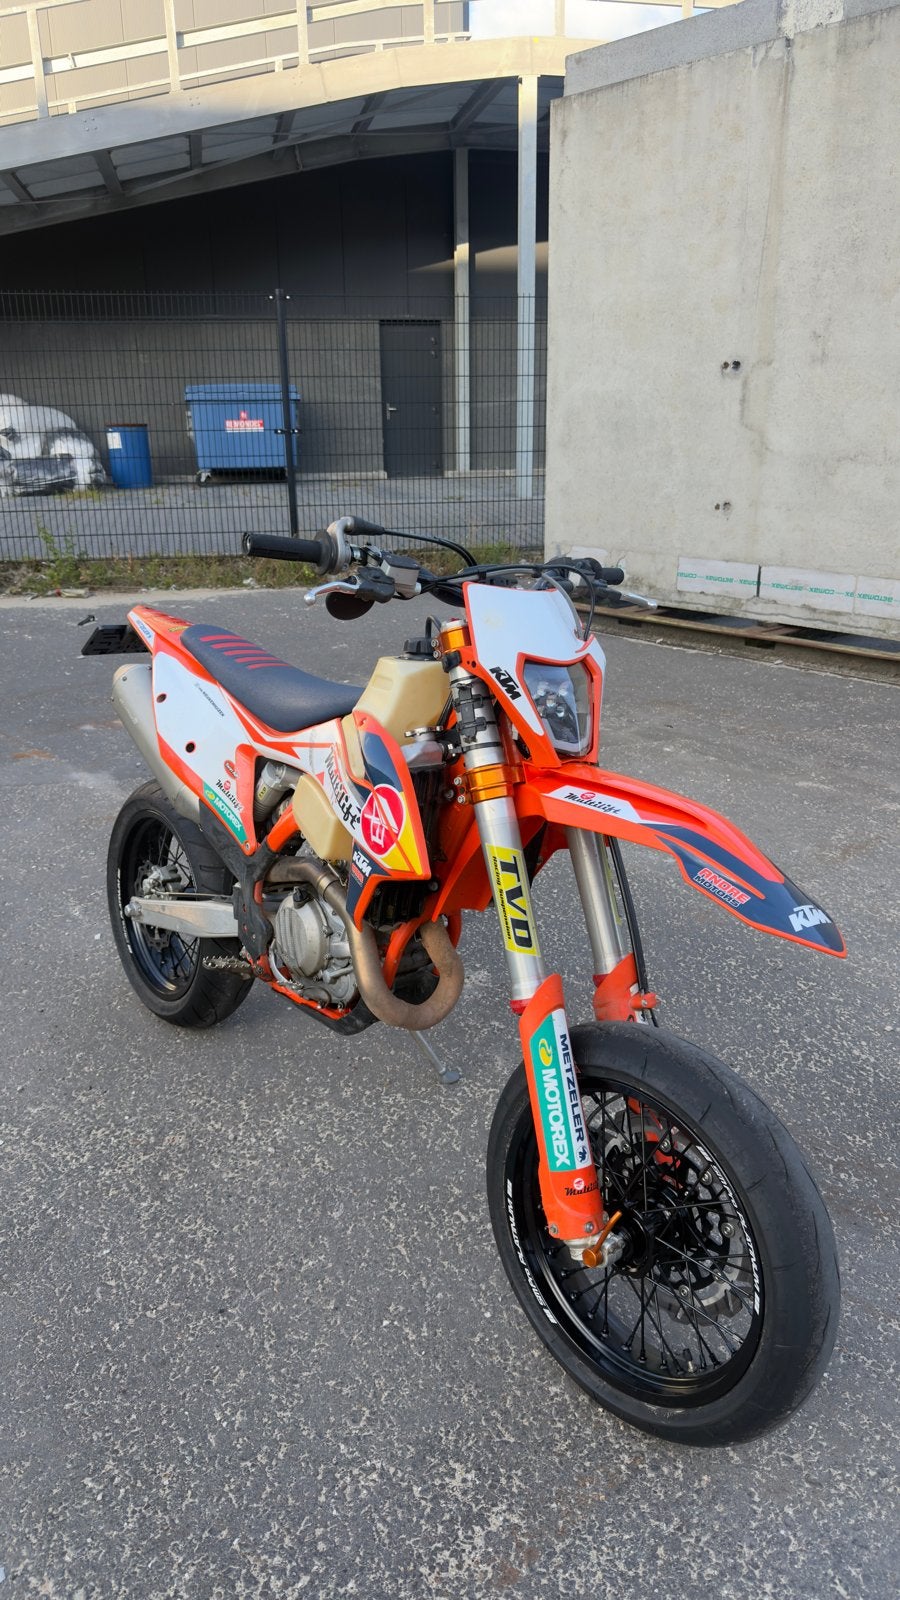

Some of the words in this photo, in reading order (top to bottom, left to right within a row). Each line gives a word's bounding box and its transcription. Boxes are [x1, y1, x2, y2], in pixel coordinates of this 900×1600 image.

[489, 666, 522, 701] KTM
[324, 744, 358, 829] Multilift
[564, 792, 621, 815] Multilift
[213, 797, 243, 832] MOTOREX
[352, 851, 373, 877] KTM
[500, 856, 532, 948] TVD
[693, 875, 740, 908] MOTORS
[698, 867, 752, 904] ANDRE
[788, 904, 833, 932] KTM
[560, 1033, 585, 1142] METZELER
[542, 1068, 571, 1168] MOTOREX
